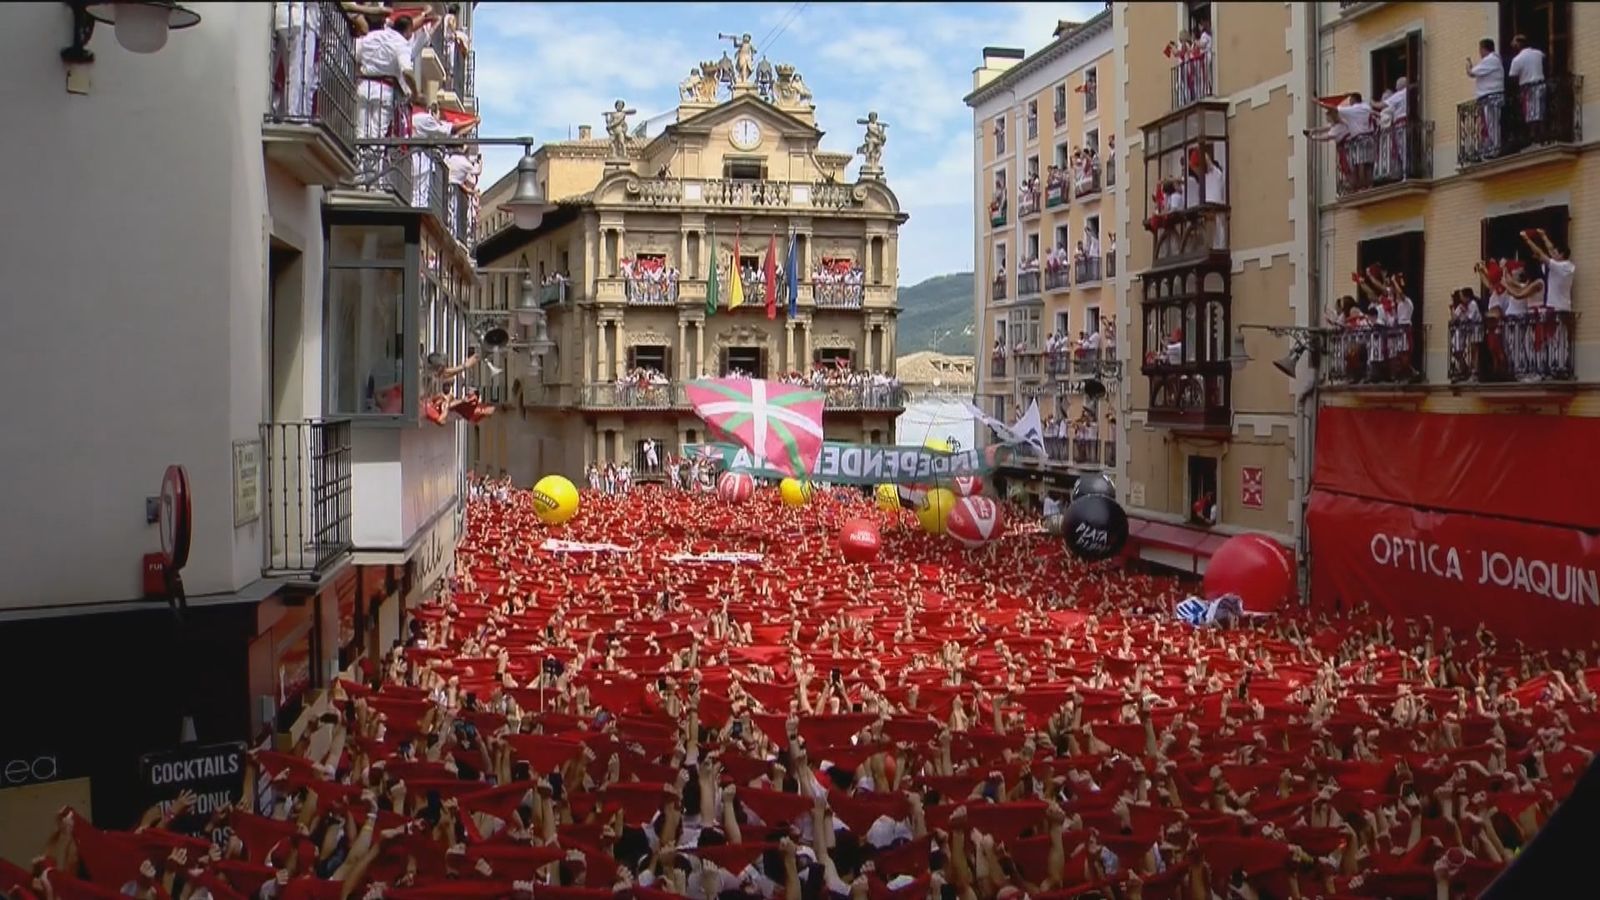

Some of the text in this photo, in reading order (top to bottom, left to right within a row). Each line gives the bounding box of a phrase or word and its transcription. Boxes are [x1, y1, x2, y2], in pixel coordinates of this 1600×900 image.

[1370, 533, 1600, 606] OPTICA JOAQUIN
[151, 753, 239, 785] COCKTAILS
